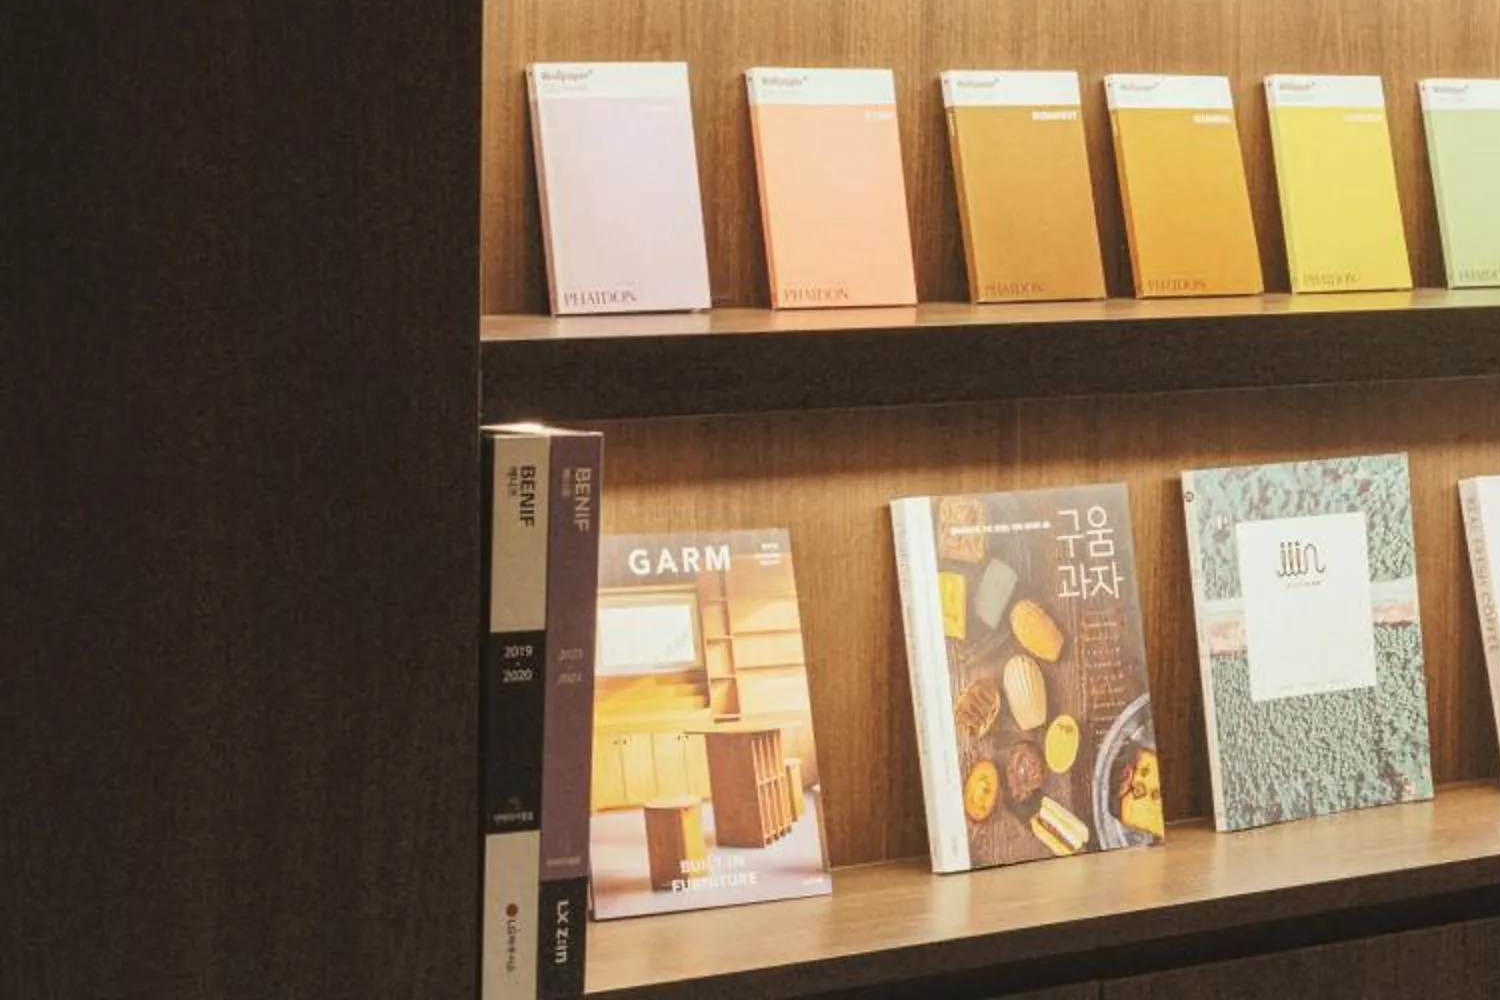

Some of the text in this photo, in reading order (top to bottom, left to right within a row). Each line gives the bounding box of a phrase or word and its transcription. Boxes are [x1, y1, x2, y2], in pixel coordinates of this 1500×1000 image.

[519, 465, 536, 528] BENIF
[573, 467, 593, 533] BENIF
[1055, 505, 1115, 559] 구움
[628, 544, 731, 575] GARM
[1056, 560, 1126, 600] 과자
[504, 645, 533, 659] 2019
[503, 668, 533, 684] 2020
